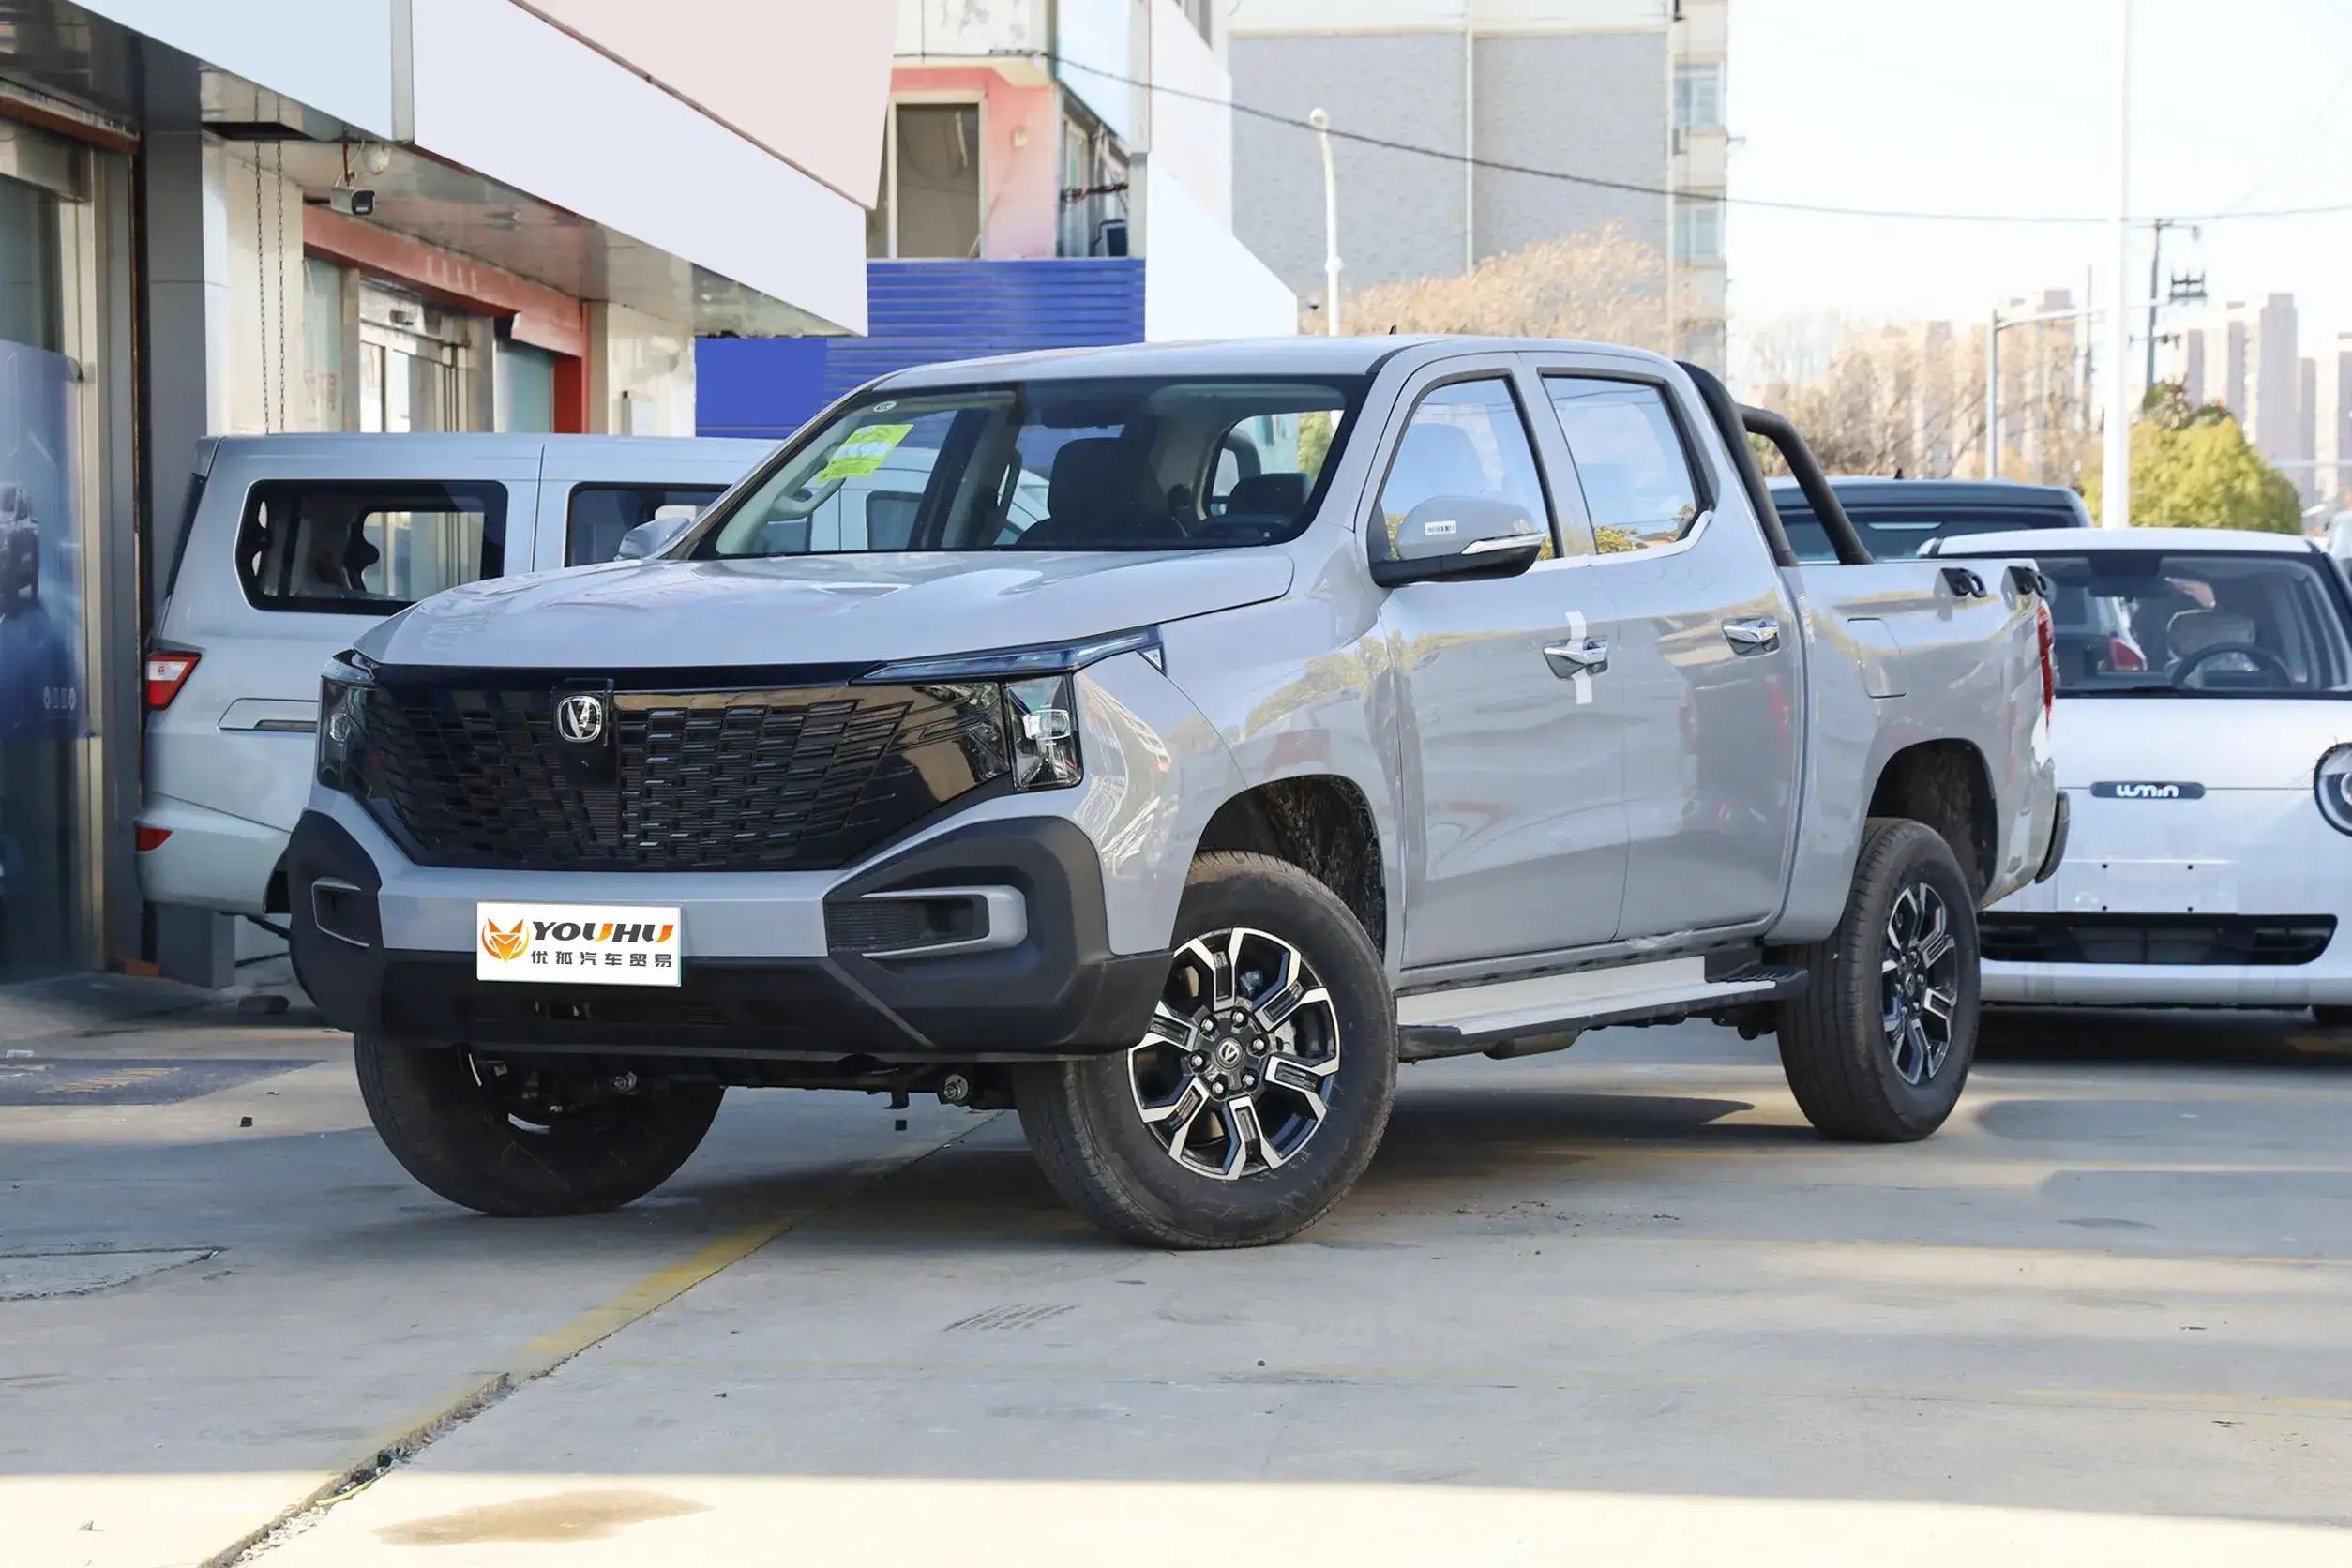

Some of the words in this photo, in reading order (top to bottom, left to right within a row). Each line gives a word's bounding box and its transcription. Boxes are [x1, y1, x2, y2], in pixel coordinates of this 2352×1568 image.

[533, 921, 674, 943] YOUHU
[531, 950, 672, 968] 优狐汽车贸易
